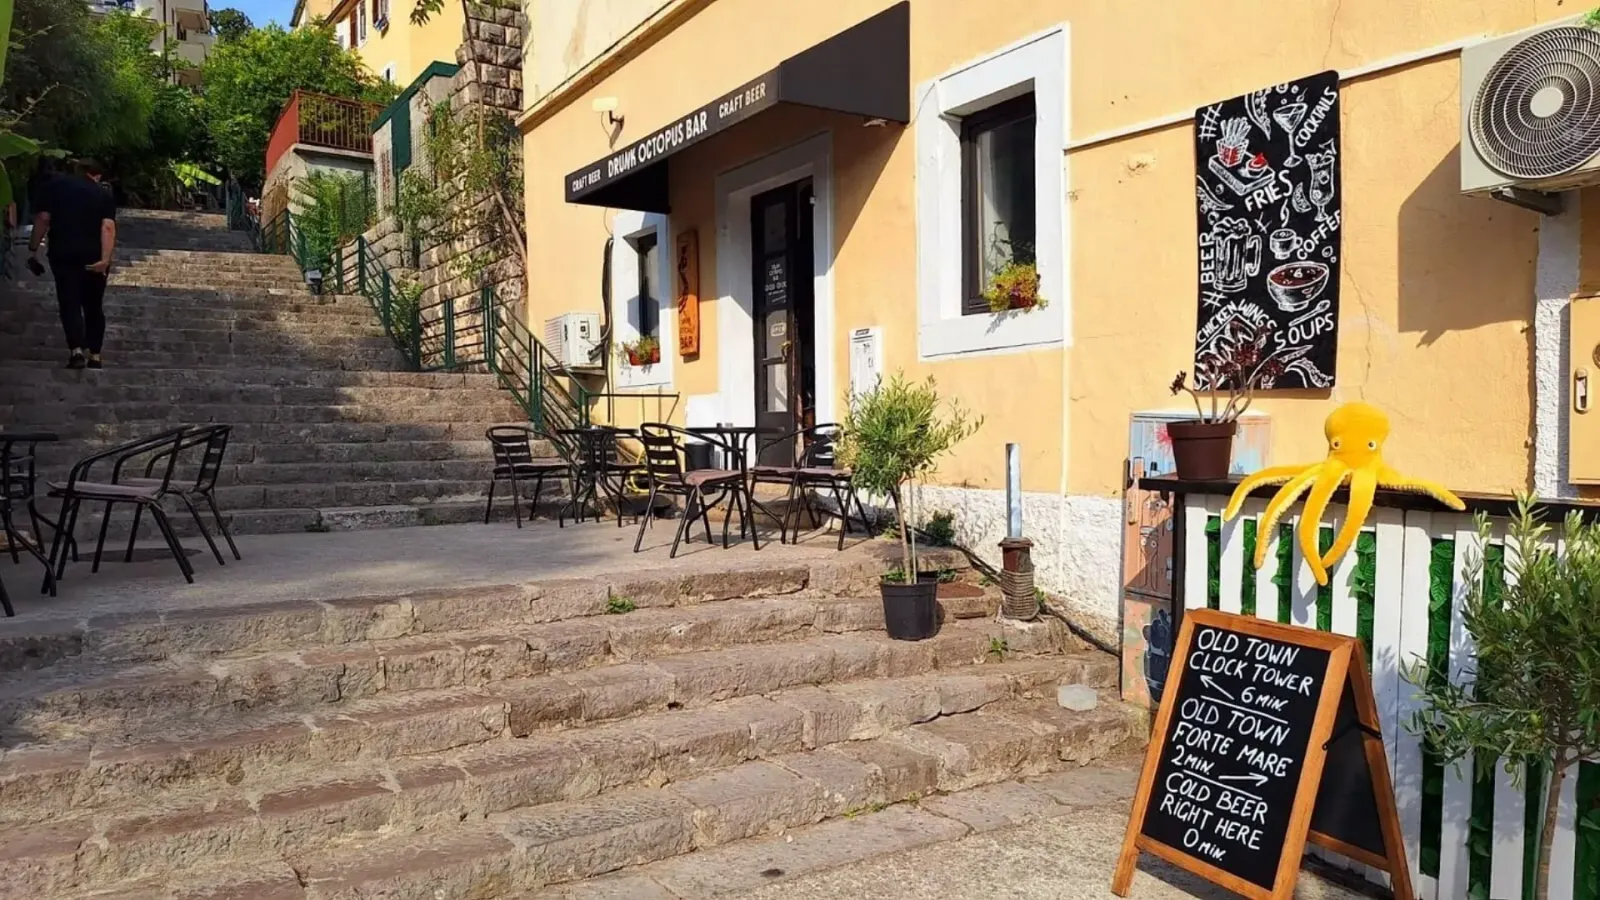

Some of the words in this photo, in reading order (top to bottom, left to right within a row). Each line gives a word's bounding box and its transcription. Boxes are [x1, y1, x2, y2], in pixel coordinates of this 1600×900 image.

[572, 175, 588, 192] CRAFT
[588, 169, 601, 185] BEER
[608, 151, 637, 178] DRUNK
[638, 127, 683, 162] OCTOPUS
[686, 111, 708, 141] BAR
[719, 94, 743, 119] CRAFT
[745, 82, 766, 106] BEER
[1295, 86, 1337, 147] COCKTAILS
[1244, 170, 1293, 212] FRIES
[1199, 232, 1214, 283] BEER
[1197, 300, 1237, 343] CHICKEN
[1274, 313, 1334, 349] SOUPS
[1198, 629, 1239, 653] OLD
[1245, 638, 1299, 666] TOWN
[1189, 651, 1248, 679] CLOCK
[1252, 664, 1313, 696] TOWER
[1241, 686, 1256, 703] 6
[1181, 698, 1219, 724] OLD
[1227, 710, 1290, 746] TOWN
[1172, 721, 1234, 755] FORTE
[1236, 745, 1293, 777] MARE
[1166, 772, 1211, 801] COLD
[1216, 791, 1268, 825] BEER
[1215, 817, 1263, 850] HERE
